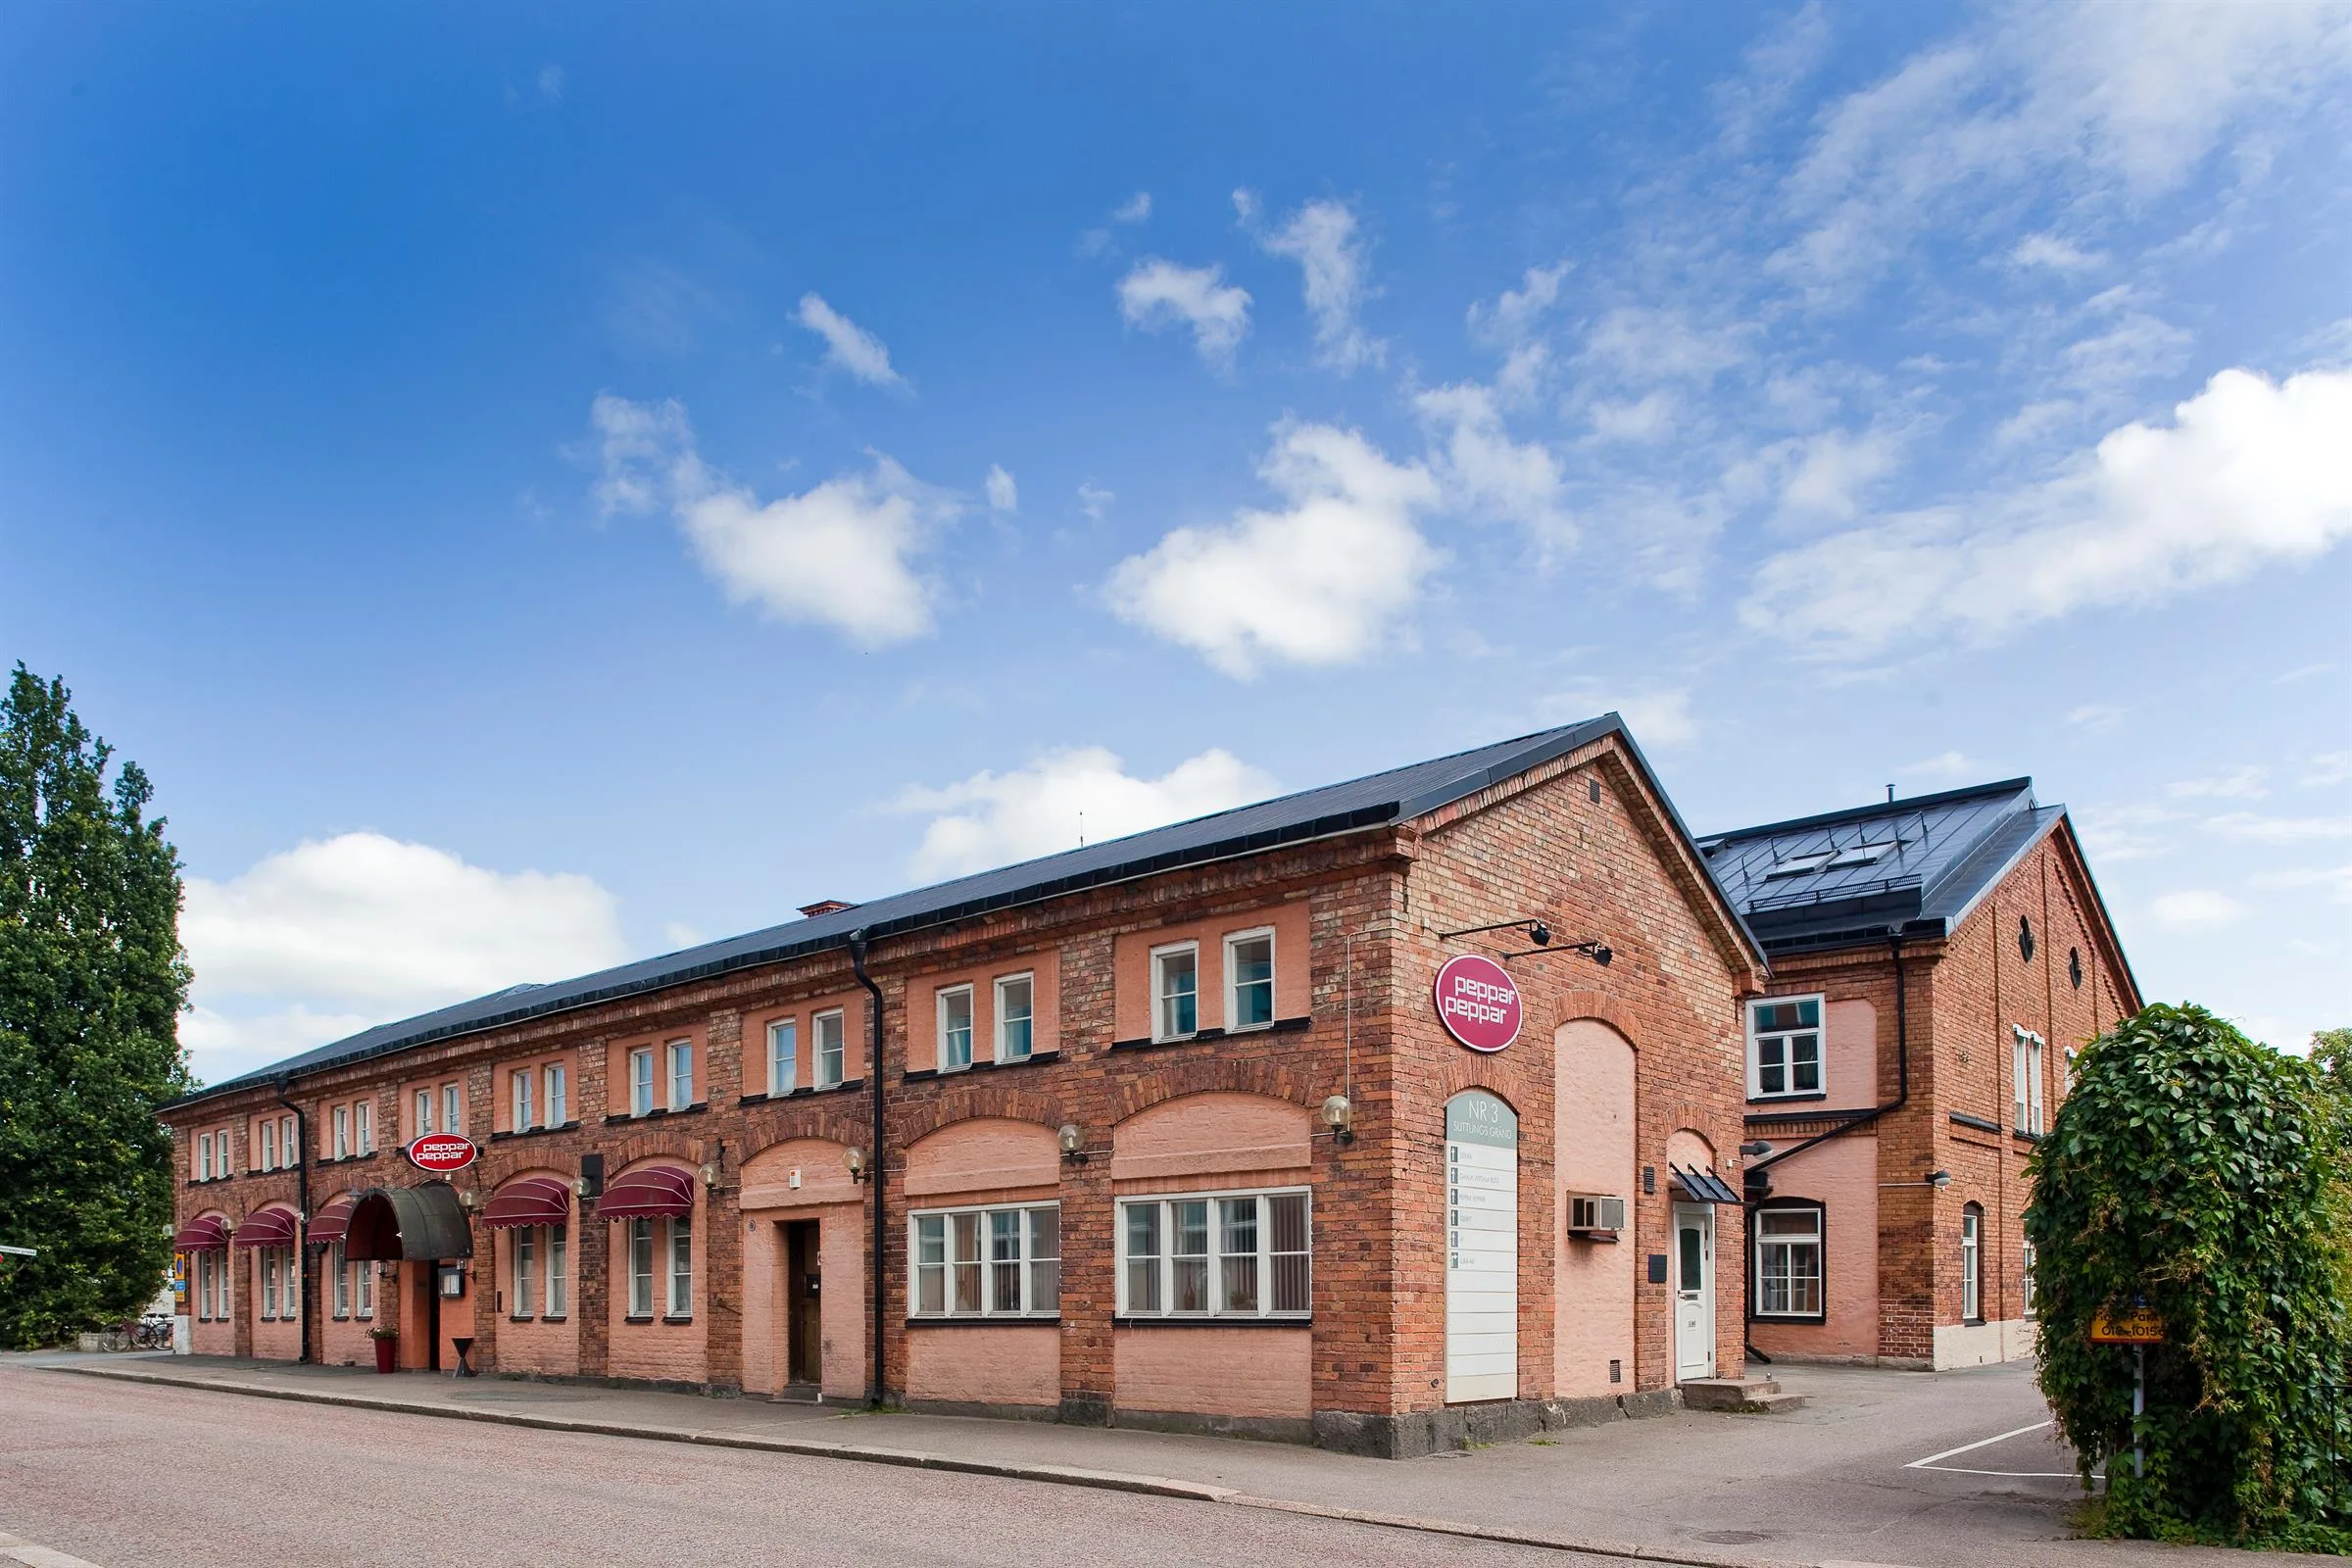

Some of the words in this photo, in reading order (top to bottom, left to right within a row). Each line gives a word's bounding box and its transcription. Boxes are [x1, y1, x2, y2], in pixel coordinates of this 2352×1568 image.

[1454, 976, 1516, 1004] peppar
[1445, 996, 1507, 1024] peppar
[1469, 1100, 1488, 1122] NR
[1491, 1103, 1498, 1123] 3
[416, 1152, 464, 1161] peppar
[423, 1143, 470, 1152] peppar
